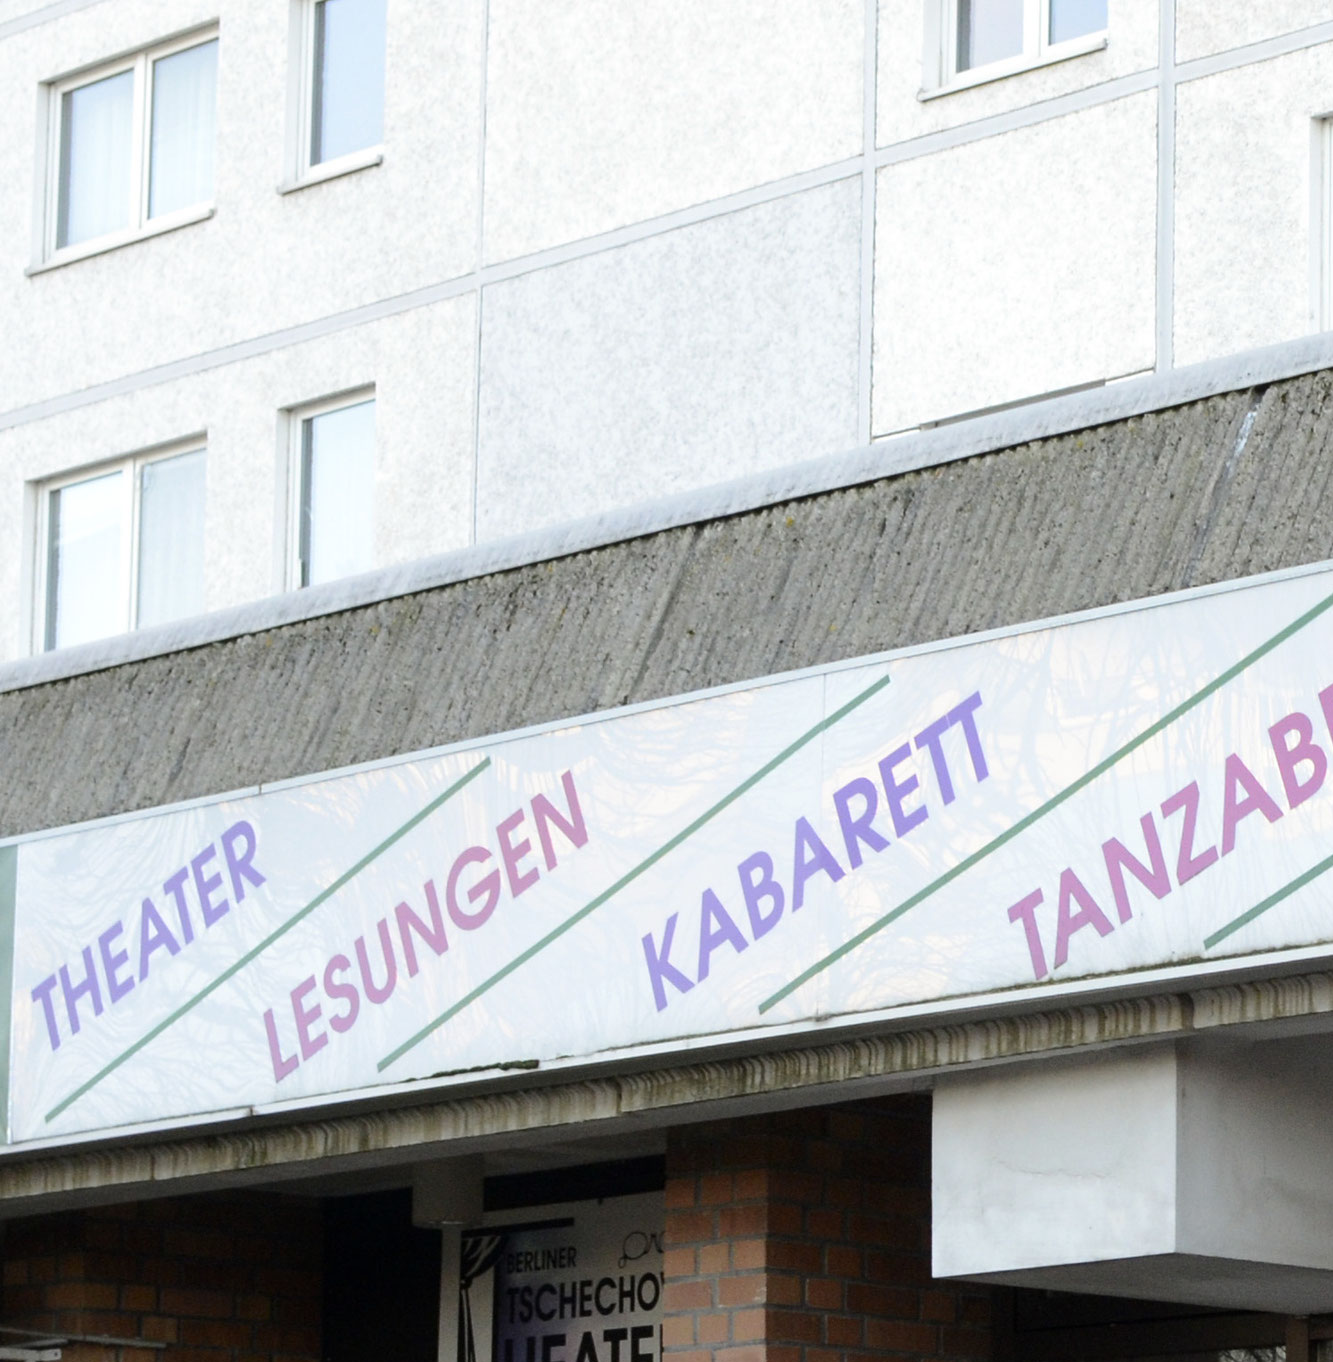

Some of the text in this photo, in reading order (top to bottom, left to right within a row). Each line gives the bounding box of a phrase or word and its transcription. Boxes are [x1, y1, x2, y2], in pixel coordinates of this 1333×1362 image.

[31, 820, 267, 1052] THEATER
[263, 771, 589, 1083] LESUNGEN
[640, 691, 990, 1013] KABARETT
[506, 1247, 577, 1274] BERLINER
[506, 1271, 664, 1324] TSCHECHO
